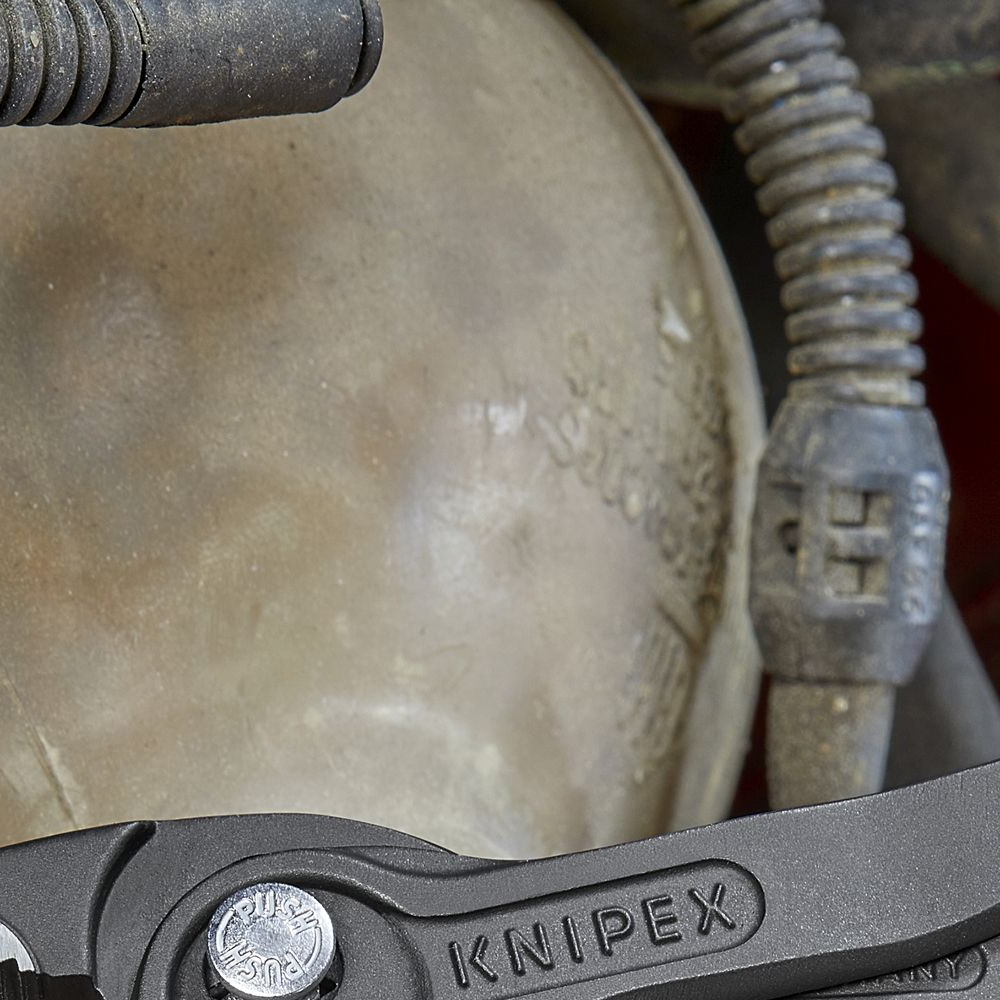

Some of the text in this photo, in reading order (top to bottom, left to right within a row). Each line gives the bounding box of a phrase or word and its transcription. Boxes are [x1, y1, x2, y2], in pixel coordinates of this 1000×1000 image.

[233, 888, 319, 937] PUSH
[449, 883, 737, 988] KNIPEX
[220, 939, 307, 988] PUSH
